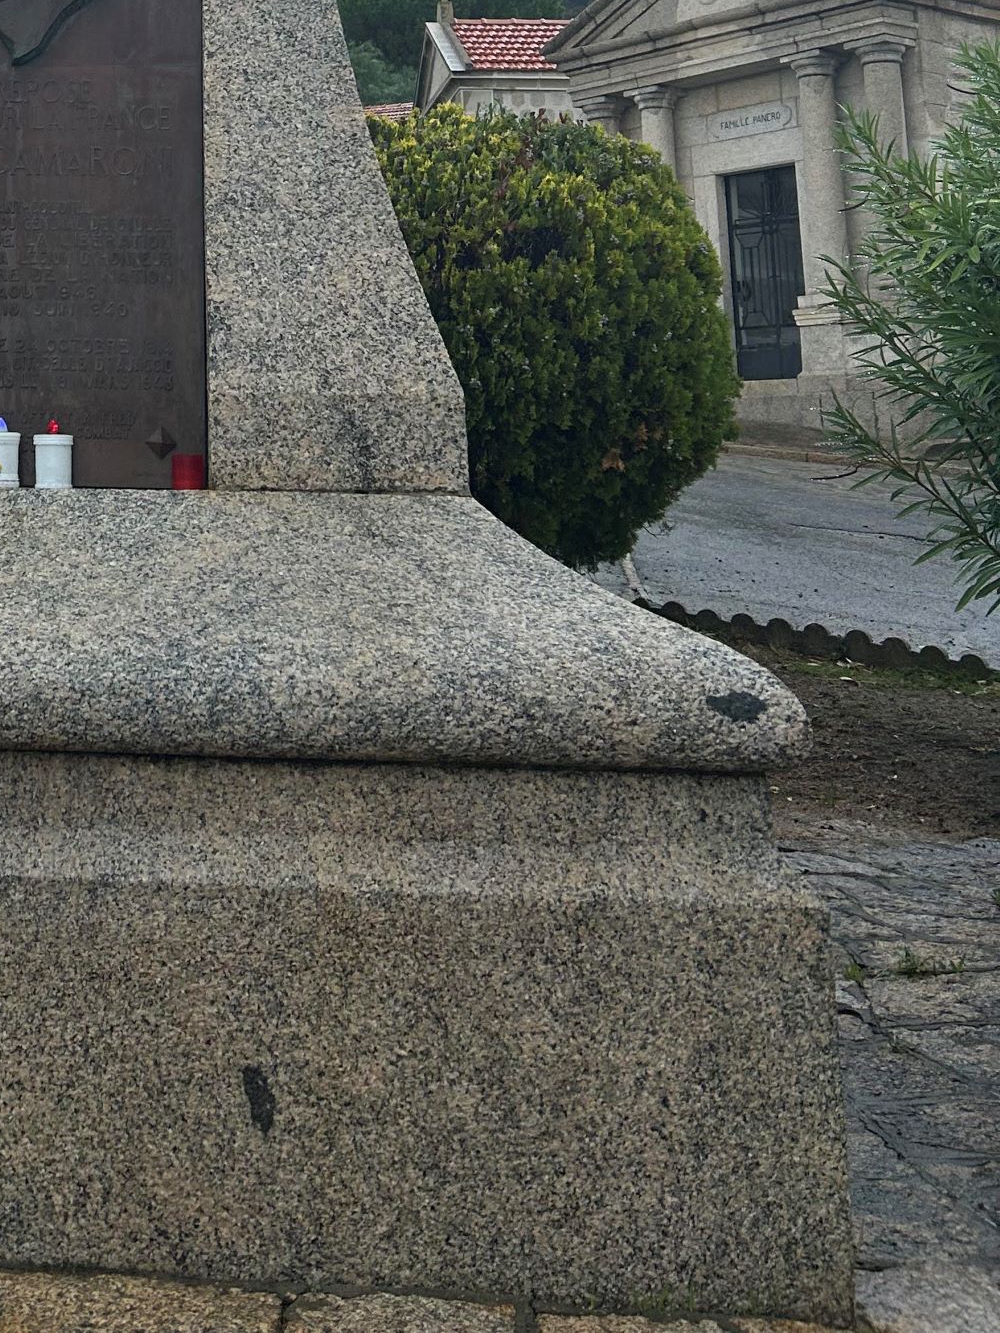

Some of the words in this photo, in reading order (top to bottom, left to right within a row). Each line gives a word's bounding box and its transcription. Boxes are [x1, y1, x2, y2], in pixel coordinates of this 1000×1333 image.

[31, 106, 64, 130] LA
[72, 106, 171, 130] FRANCE
[720, 116, 750, 130] FAMILLE
[753, 111, 780, 124] PANERO
[47, 337, 130, 354] OCTOBRE
